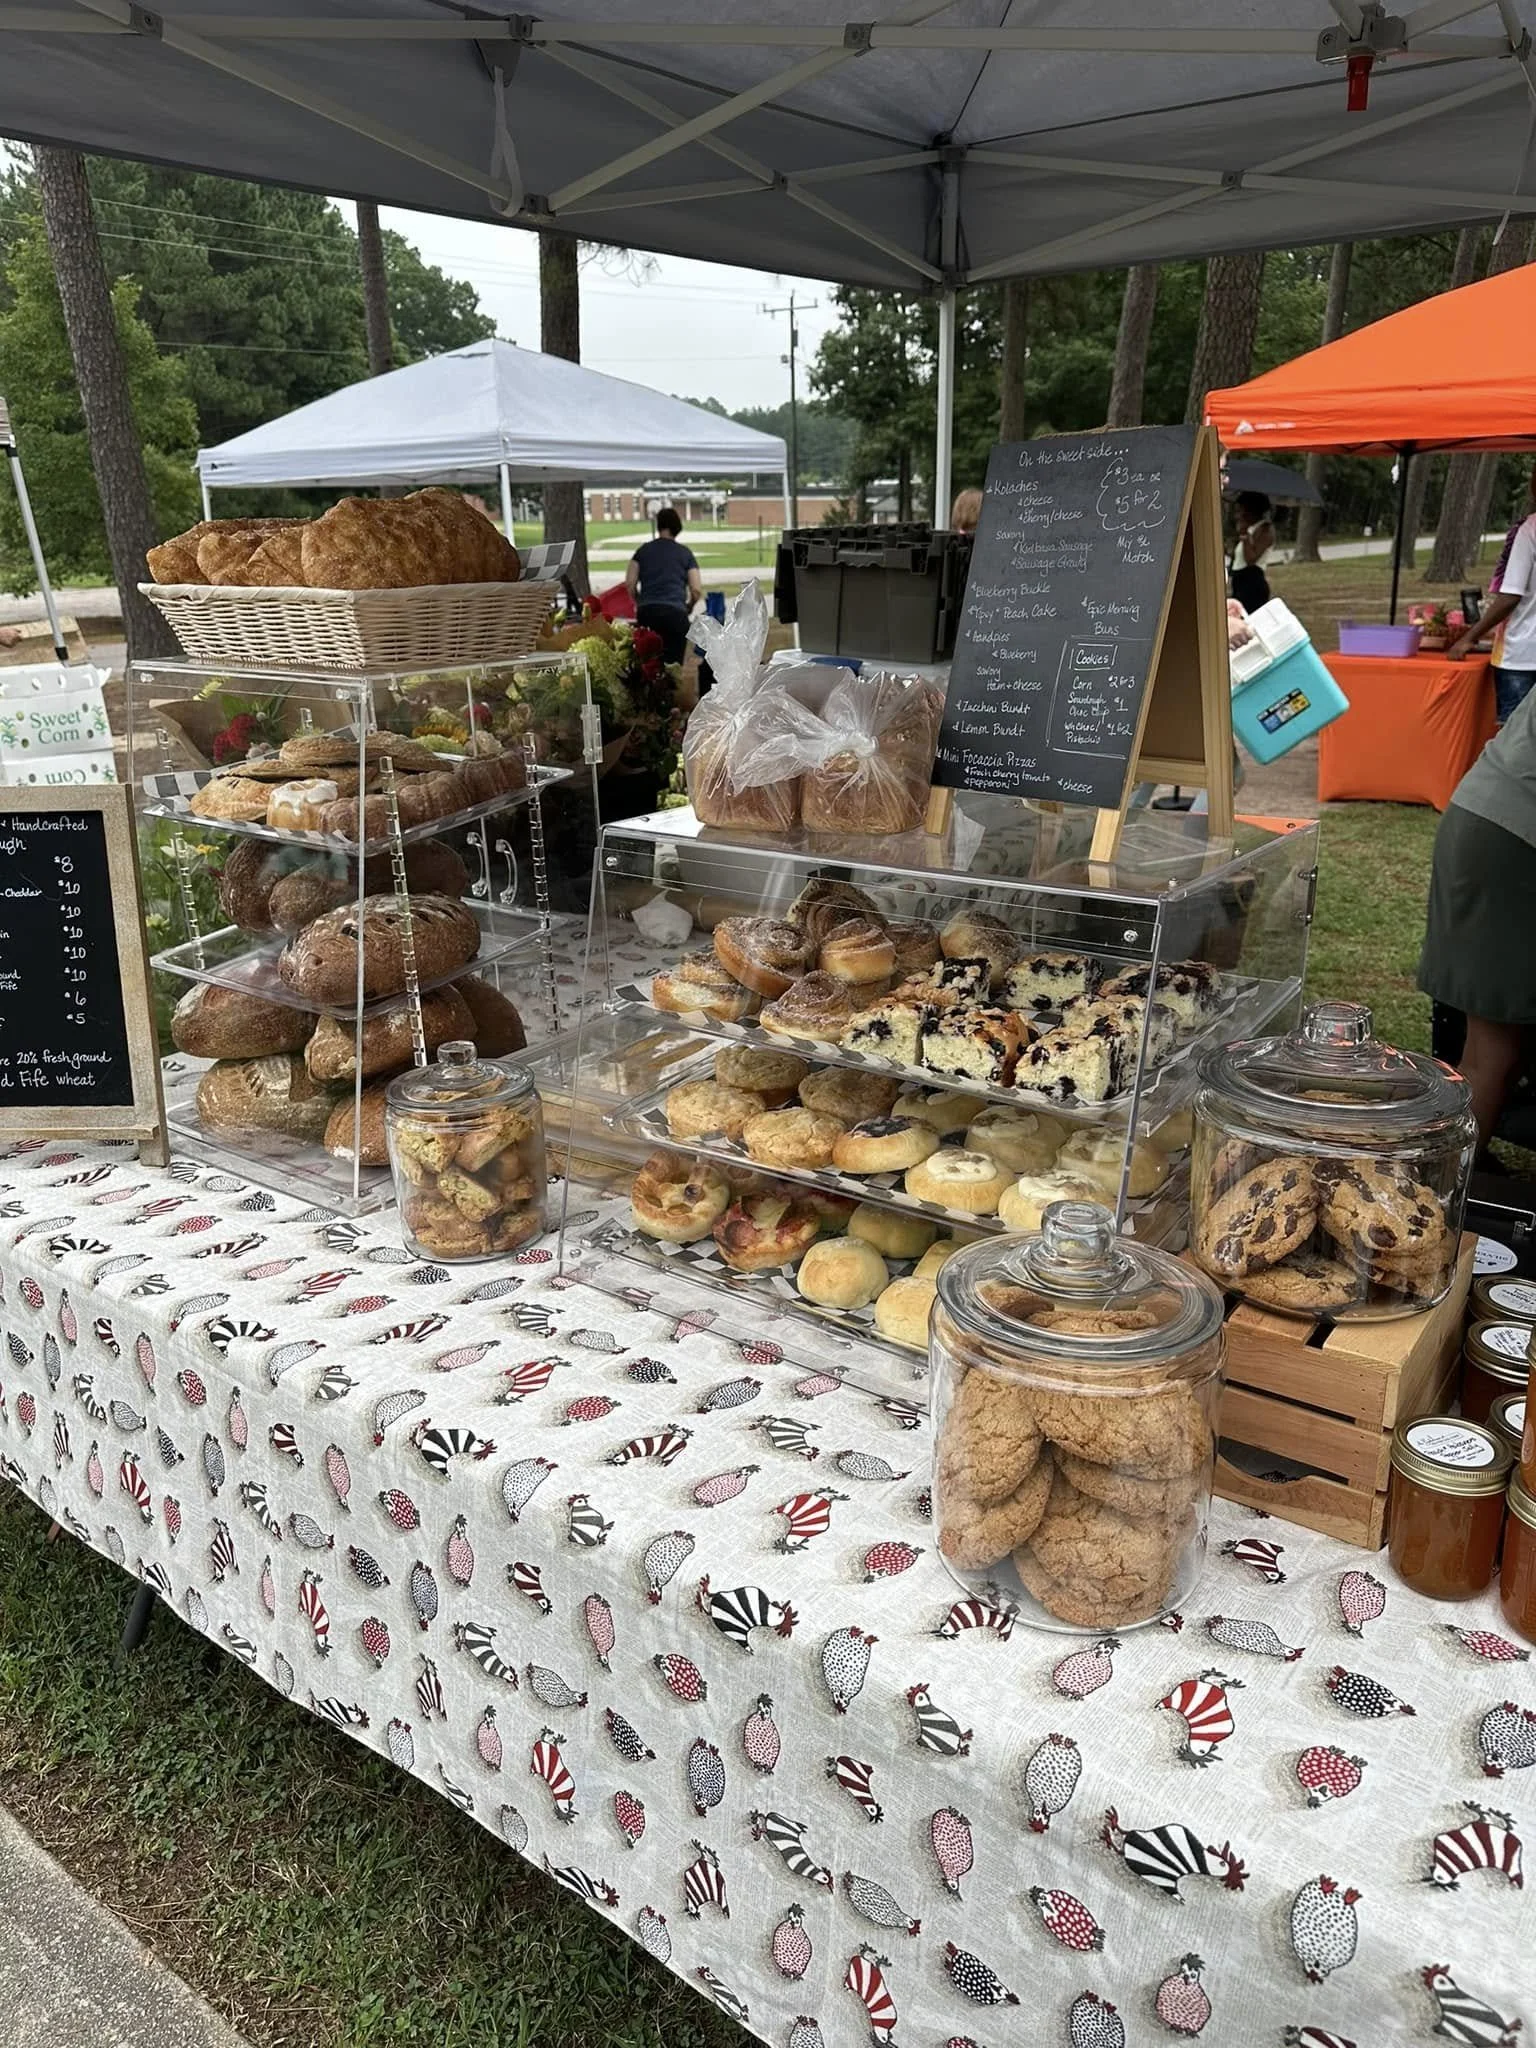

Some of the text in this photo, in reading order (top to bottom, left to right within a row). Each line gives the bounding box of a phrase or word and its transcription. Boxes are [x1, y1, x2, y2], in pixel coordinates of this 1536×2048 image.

[1019, 451, 1033, 467] On
[1037, 450, 1053, 464] the
[1056, 446, 1085, 463] sweet
[1115, 467, 1129, 485] $3
[994, 480, 1039, 495] Kolaches
[1115, 489, 1163, 514] $5 for 2
[1122, 551, 1155, 564] Match
[976, 582, 1051, 603] Blueberry Buckle
[1003, 606, 1029, 618] Peach
[1031, 603, 1057, 617] Cake
[1094, 621, 1120, 636] Buns
[1075, 649, 1109, 665] Cookies
[1072, 675, 1093, 690] Corn
[1128, 676, 1135, 688] 3
[962, 700, 1031, 714] Zucchini Bundt
[30, 710, 81, 729] Sweet
[961, 720, 1026, 737] Lemon Bundt
[1122, 723, 1133, 736] 2
[38, 728, 80, 745] Corn
[1065, 731, 1101, 745] Pistachio
[943, 747, 1036, 768] Mini Focaccia Pizzas
[54, 856, 74, 873] $8
[58, 880, 81, 895] $10
[60, 904, 81, 919] $10
[63, 926, 84, 939] $10
[63, 946, 86, 960] $10
[64, 967, 87, 982] $10
[66, 1013, 86, 1024] $5
[16, 1050, 38, 1065] 20%
[19, 1068, 49, 1088] Fife
[56, 1072, 96, 1086] wheat
